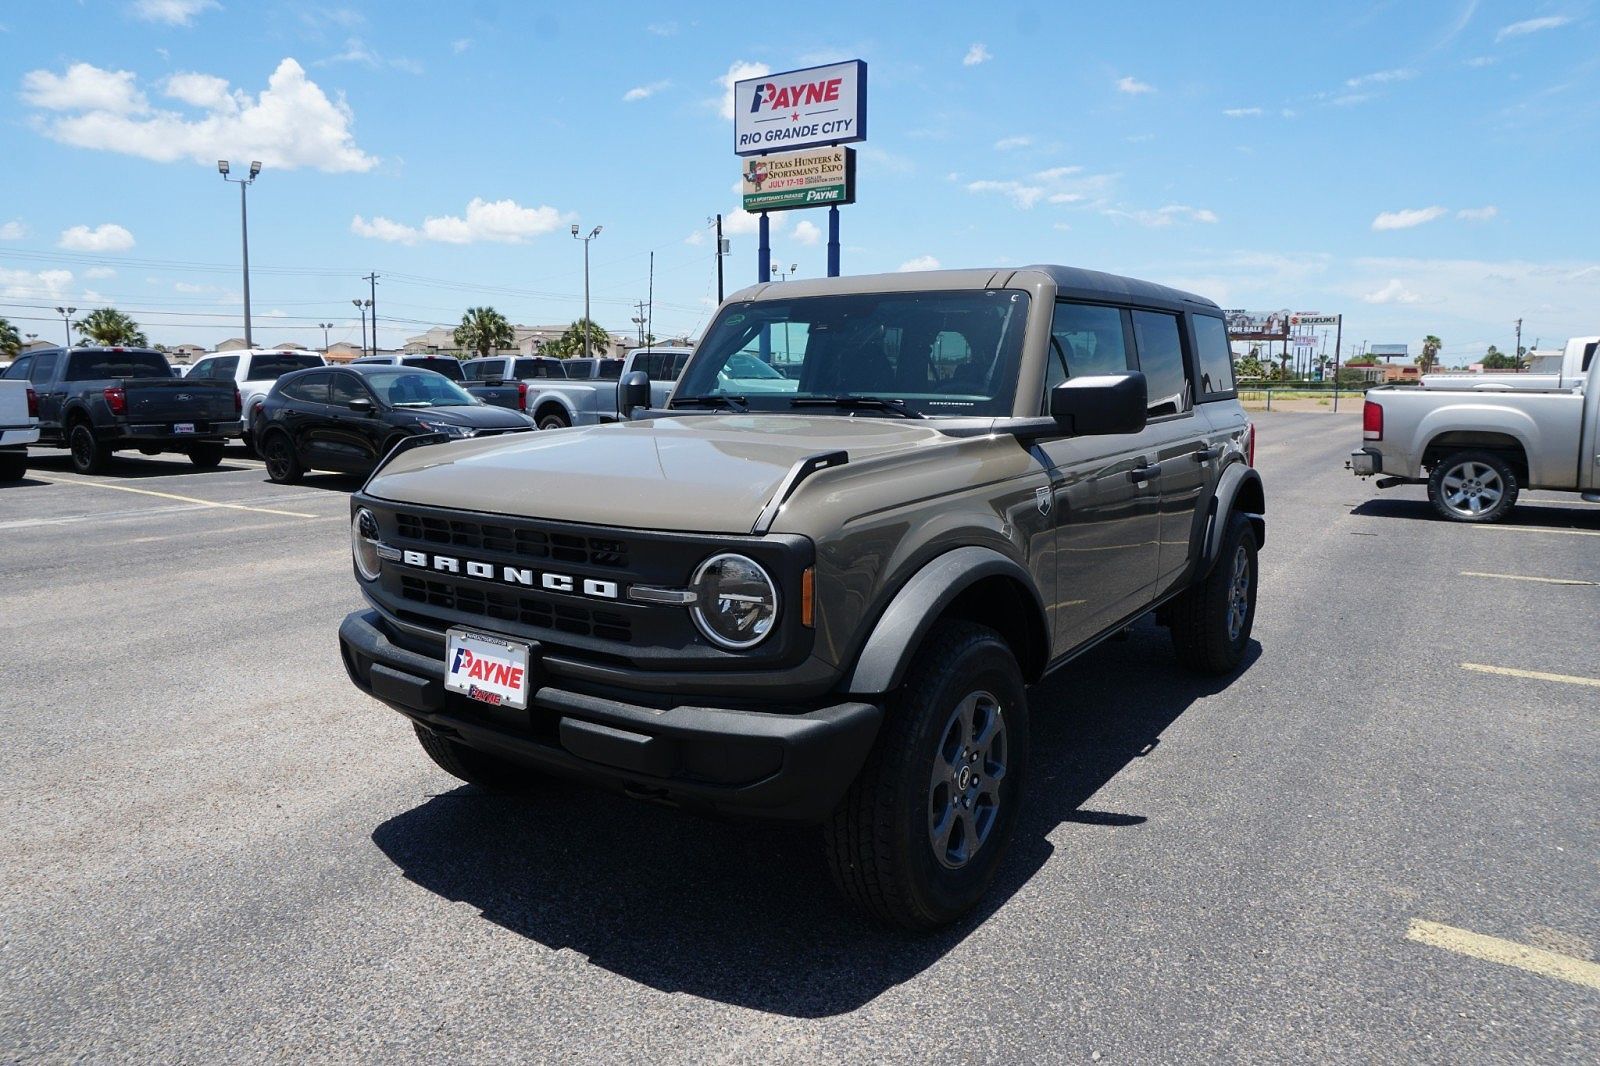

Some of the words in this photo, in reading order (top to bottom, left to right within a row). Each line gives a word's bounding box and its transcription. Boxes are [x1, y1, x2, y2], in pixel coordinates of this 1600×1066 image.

[750, 78, 842, 113] PAYNE
[740, 132, 762, 146] RIO
[765, 124, 819, 142] GRANDE
[822, 118, 853, 133] CITY
[768, 160, 793, 170] TEXAS
[794, 155, 832, 167] HUNTERS
[833, 153, 842, 162] &
[768, 166, 819, 180] SPORTSMAN'S
[821, 164, 843, 173] EXPO
[768, 180, 786, 189] JULY
[786, 178, 804, 187] 17-19
[806, 190, 839, 202] PAYNE
[404, 550, 618, 598] BRONCO
[451, 648, 524, 690] PAYNE
[468, 684, 501, 705] PAYNE
